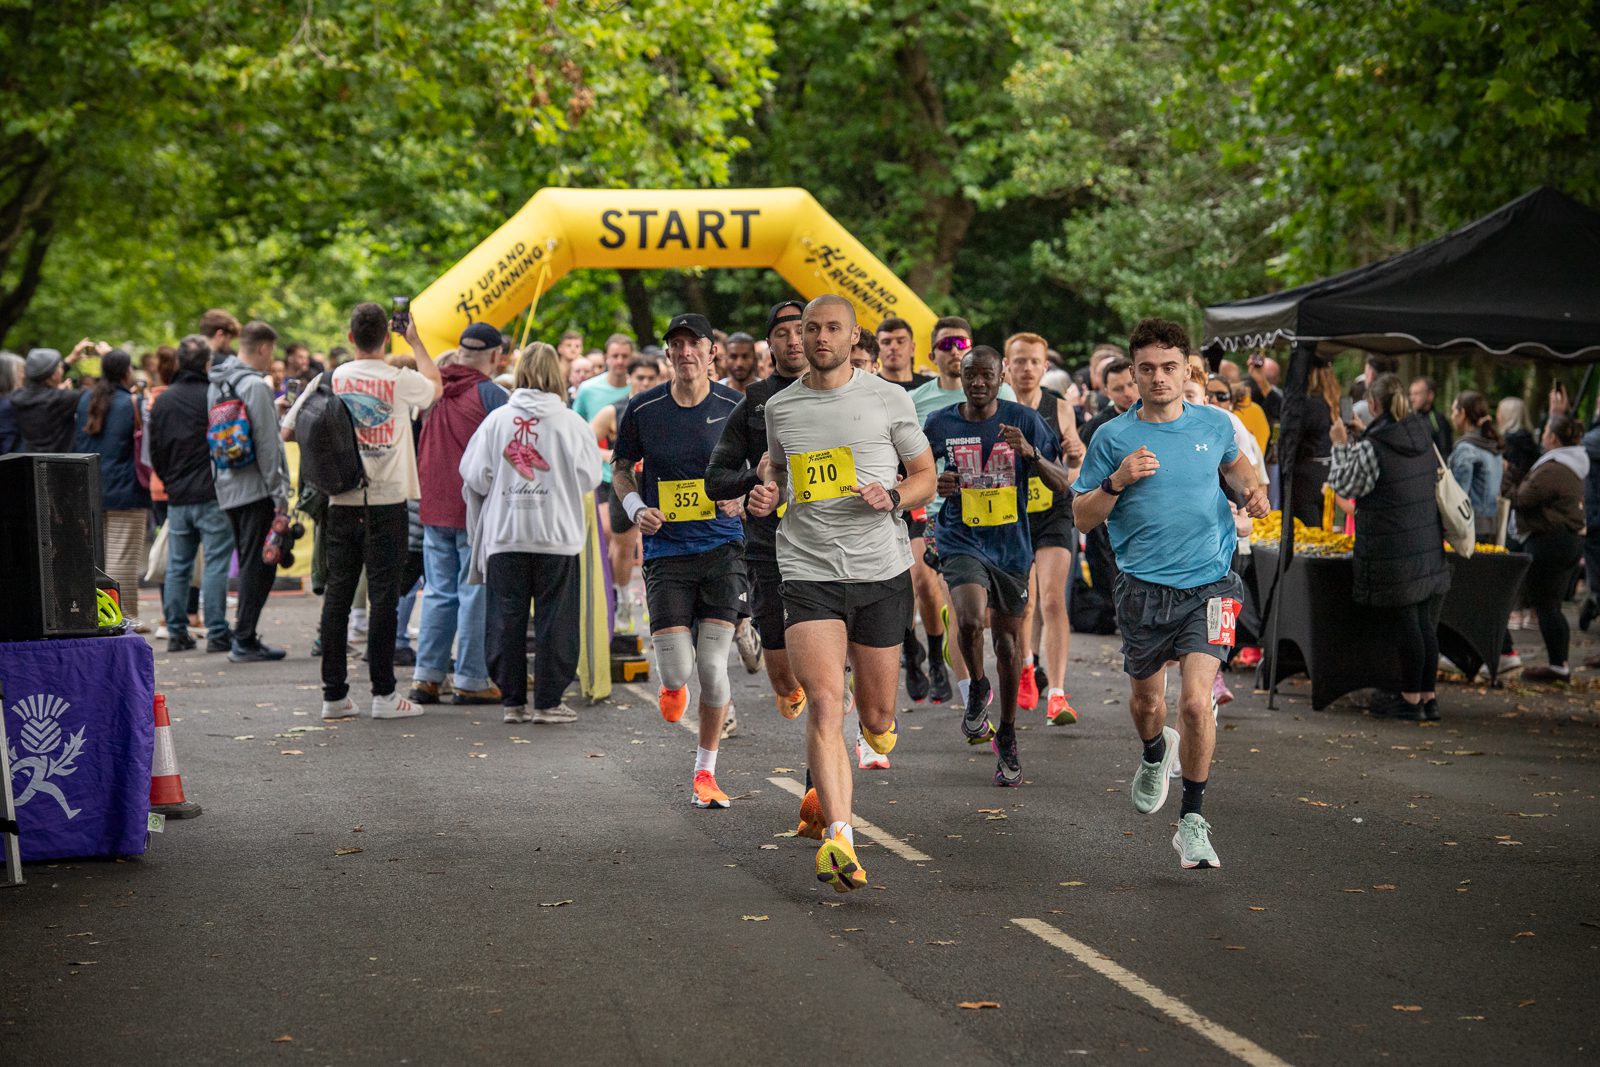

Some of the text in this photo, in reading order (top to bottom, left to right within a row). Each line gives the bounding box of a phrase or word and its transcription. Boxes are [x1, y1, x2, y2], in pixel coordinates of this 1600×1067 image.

[599, 208, 760, 249] START
[478, 269, 495, 290] UP
[497, 242, 525, 273] AND
[481, 246, 543, 308] RUNNING
[846, 263, 897, 304] UP AND
[945, 437, 981, 446] FINISHER
[807, 463, 838, 485] 210
[674, 492, 699, 508] 352
